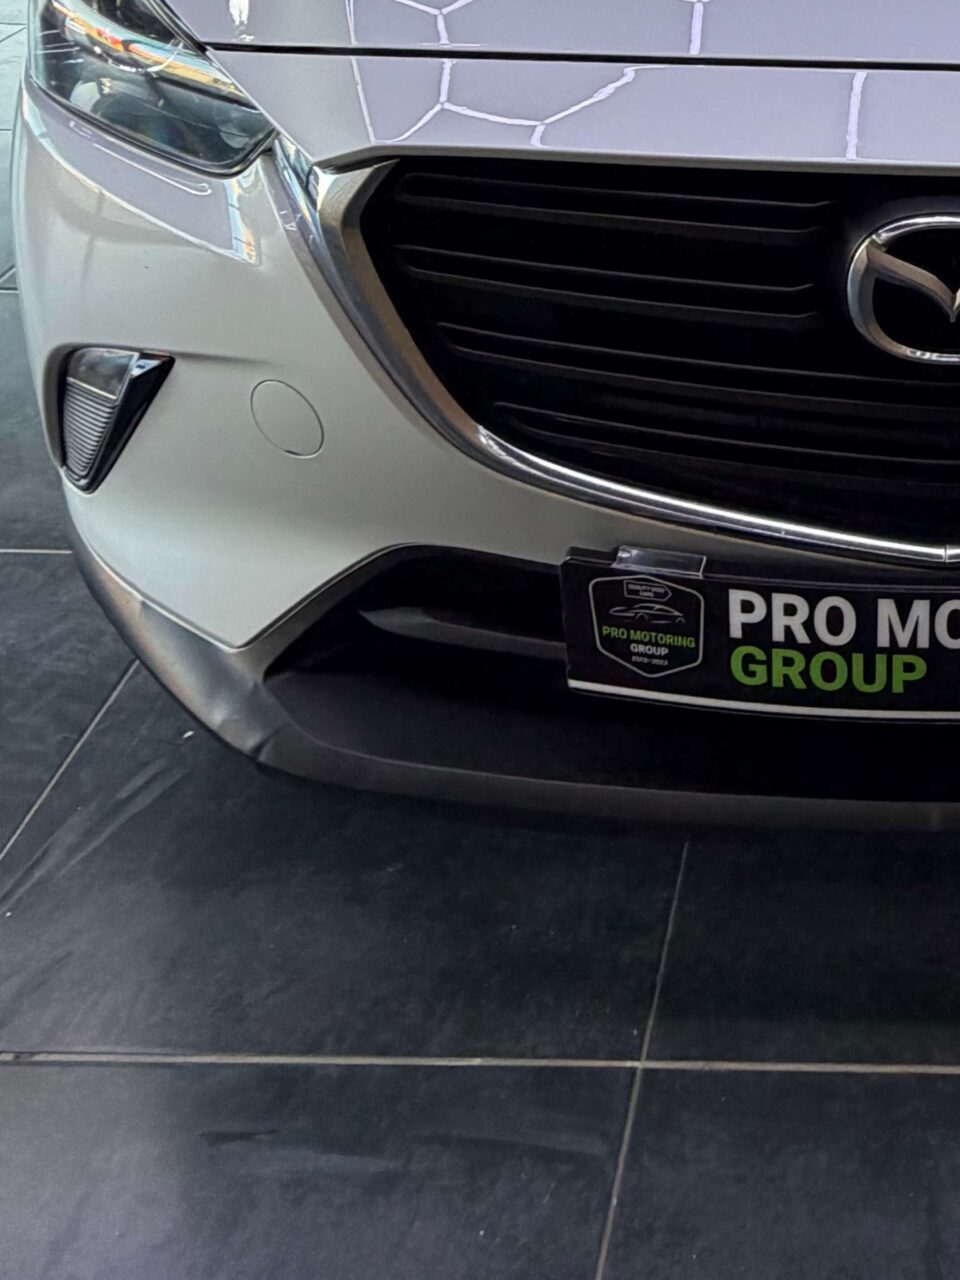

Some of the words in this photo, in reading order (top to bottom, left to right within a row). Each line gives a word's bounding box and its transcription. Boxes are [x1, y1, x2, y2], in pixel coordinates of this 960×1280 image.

[728, 588, 857, 647] PRO
[602, 625, 628, 639] PRO
[629, 629, 696, 648] MOTORING
[630, 643, 669, 656] GROUP
[730, 645, 928, 694] GROUP
